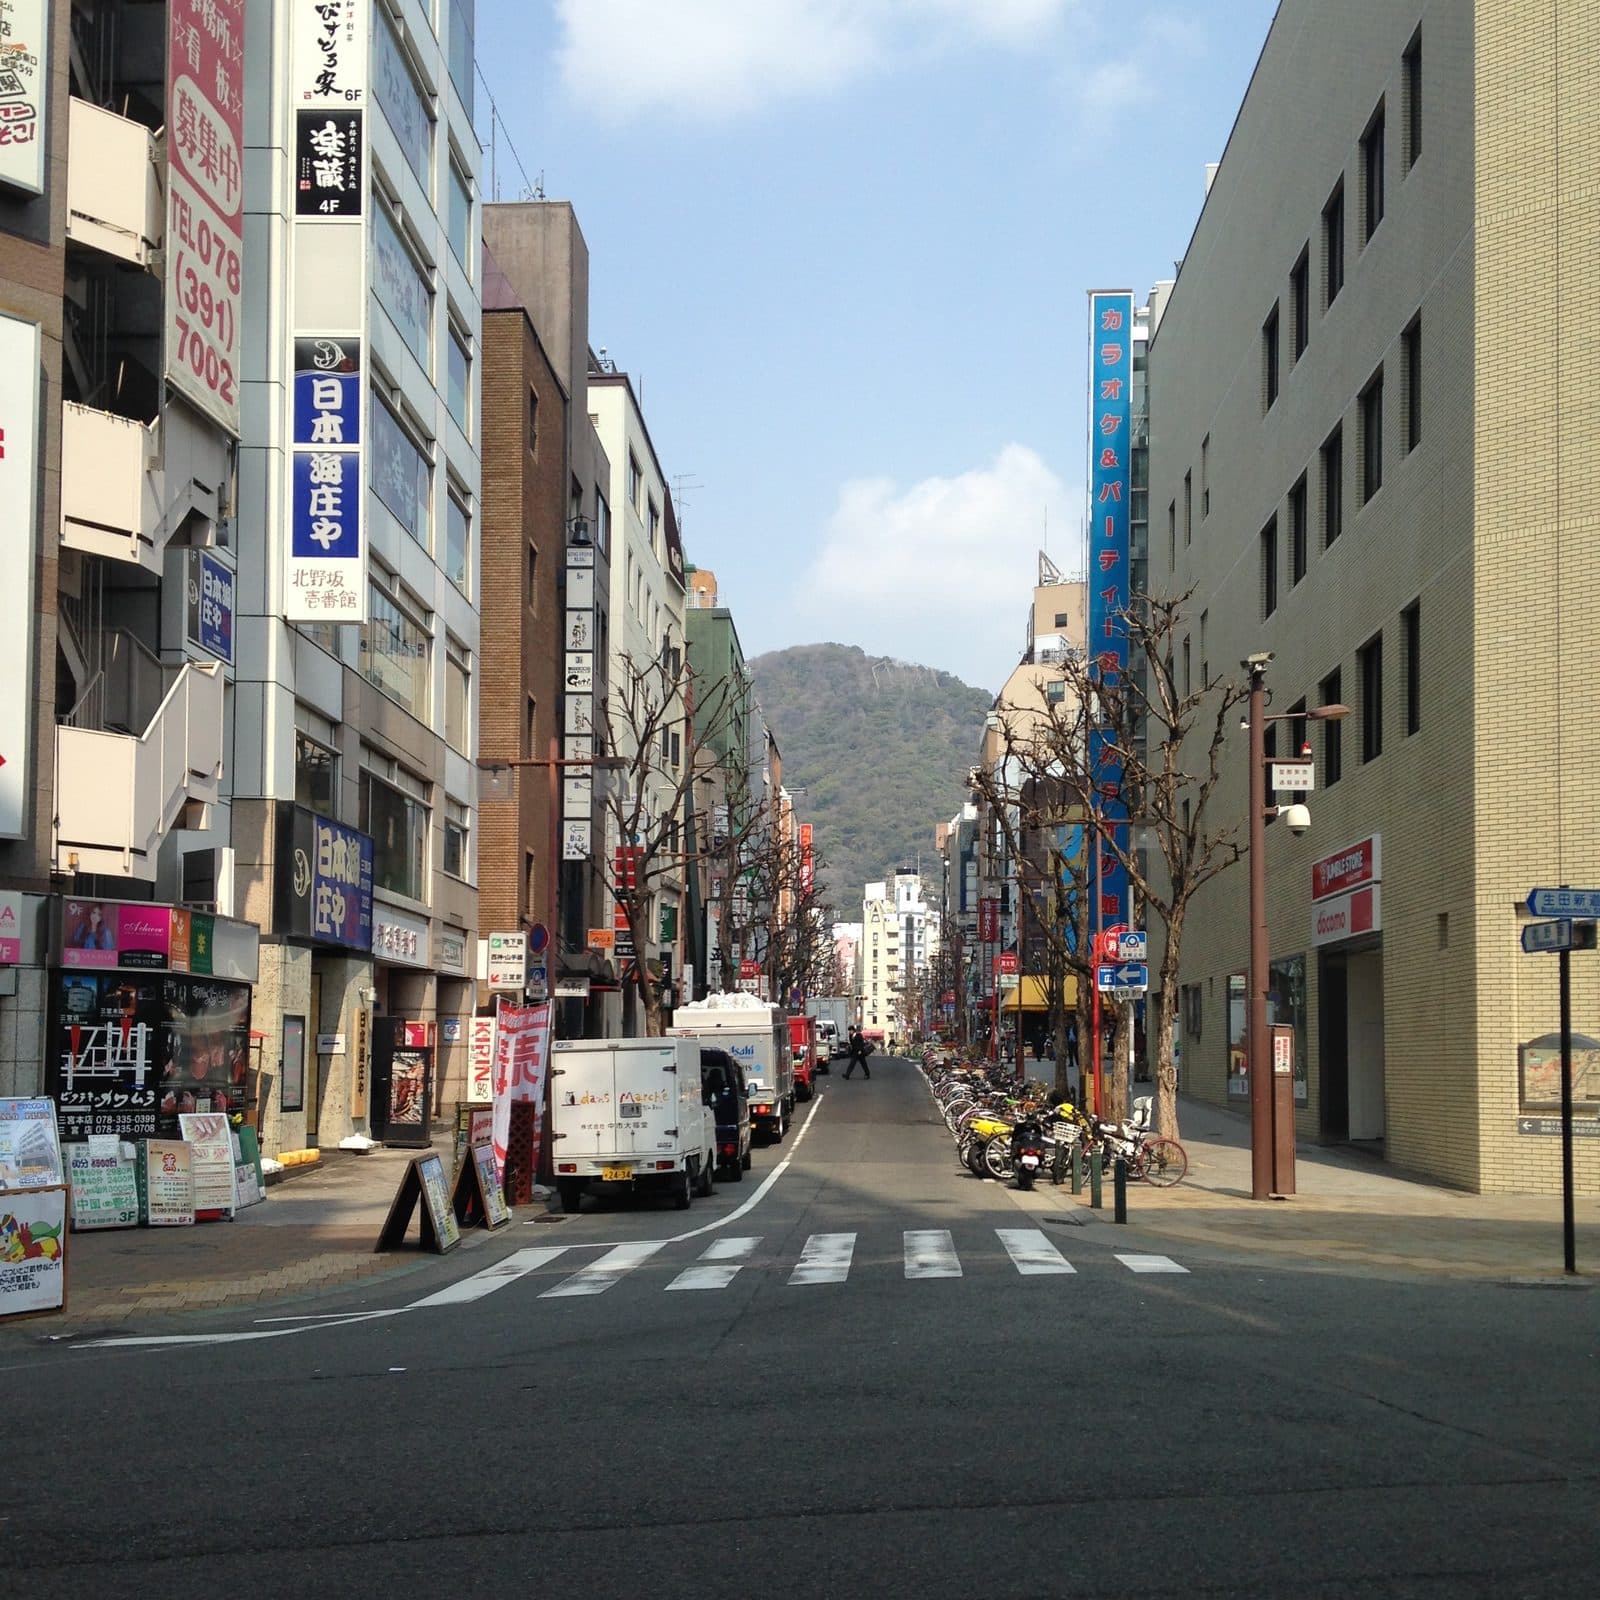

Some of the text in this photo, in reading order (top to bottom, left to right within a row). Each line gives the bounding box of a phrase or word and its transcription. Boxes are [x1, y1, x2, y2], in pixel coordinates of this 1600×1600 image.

[345, 89, 362, 101] 6F
[176, 88, 237, 203] 募集中
[310, 120, 346, 191] 楽蔵
[319, 199, 340, 213] 4F
[171, 188, 240, 295] TEL 078
[176, 250, 234, 353] (391)
[176, 314, 234, 406] 7002
[292, 568, 344, 587] 北野坂
[1317, 910, 1345, 935] docomo
[475, 1021, 491, 1083] KIRIN
[58, 1115, 156, 1125] 三宮本店 078-335-0399
[119, 1211, 136, 1223] 3F
